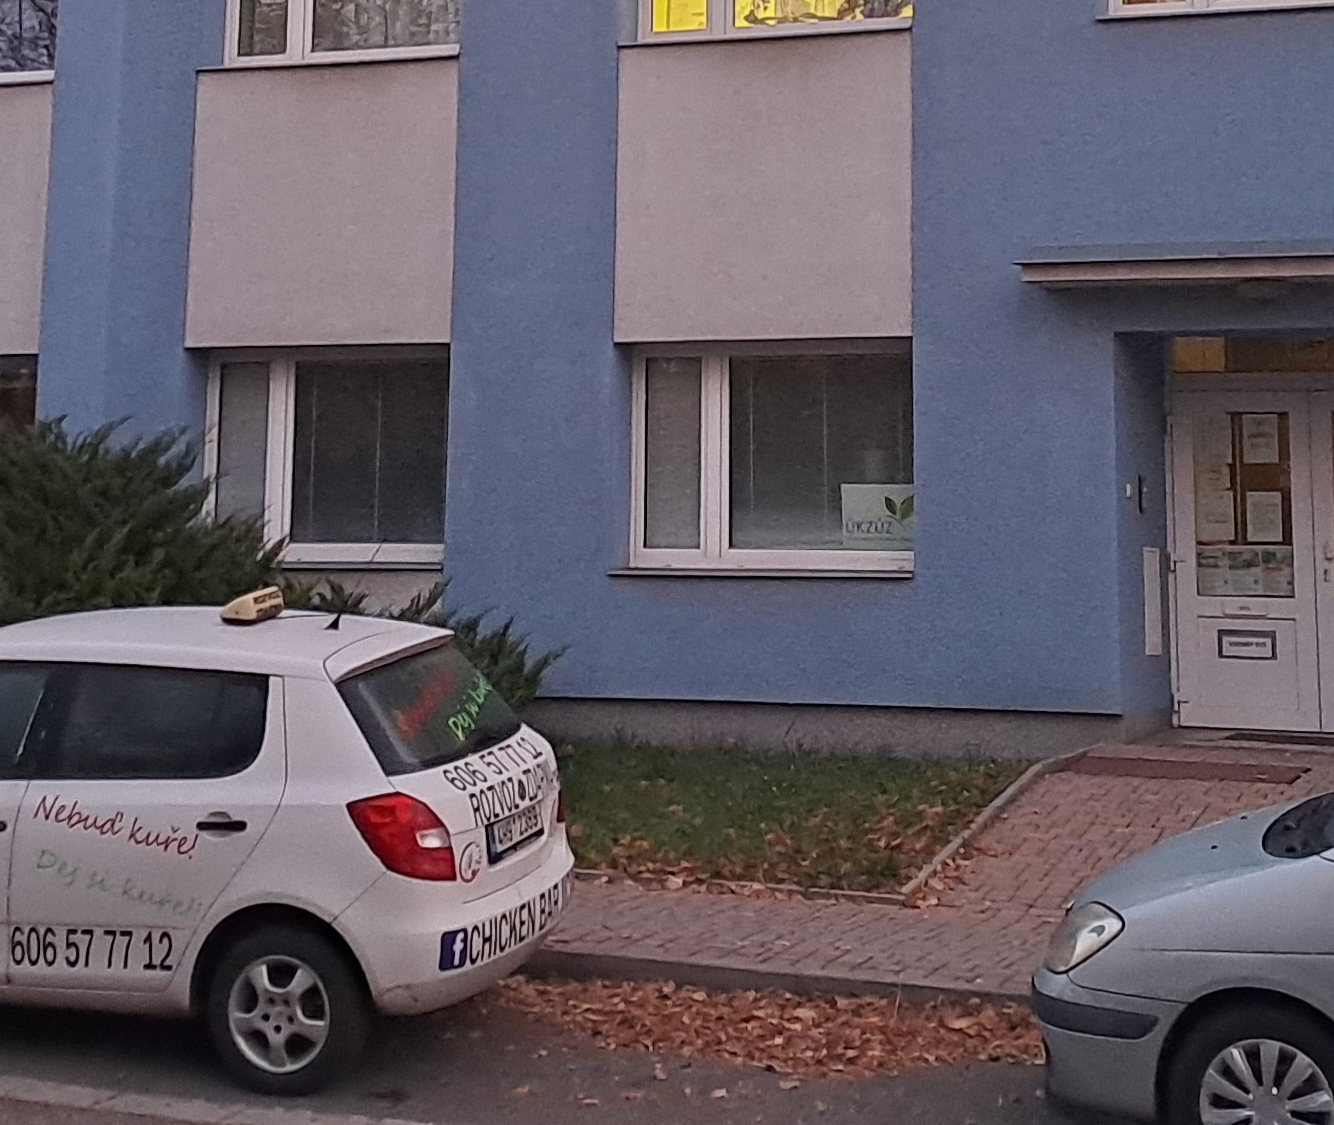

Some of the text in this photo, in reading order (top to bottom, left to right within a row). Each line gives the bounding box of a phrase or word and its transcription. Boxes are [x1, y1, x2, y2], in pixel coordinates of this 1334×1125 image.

[443, 736, 543, 792] 606 57 77 12
[33, 794, 199, 860] Nebuď kuře!
[468, 776, 519, 828] ROZVOZ
[10, 925, 58, 968] 606
[65, 928, 95, 969] 57
[103, 929, 133, 970] 77
[142, 930, 174, 972] 12
[468, 897, 536, 966] CHICKEN
